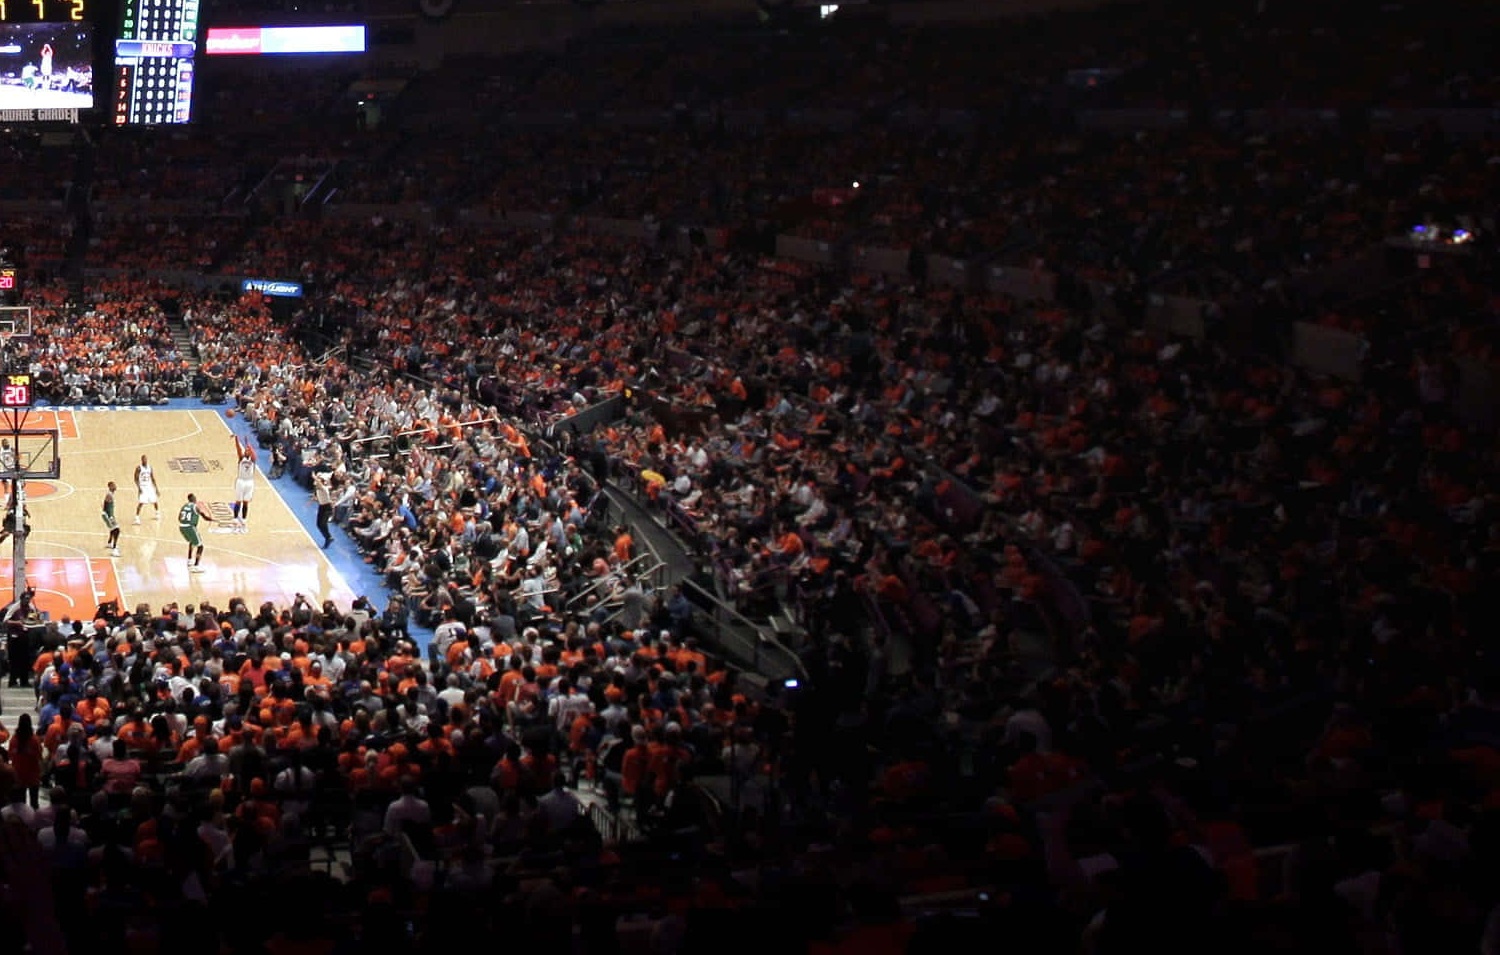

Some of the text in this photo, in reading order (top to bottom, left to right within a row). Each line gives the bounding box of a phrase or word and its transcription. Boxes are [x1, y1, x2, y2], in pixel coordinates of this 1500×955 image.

[71, 0, 84, 20] 2
[38, 108, 79, 124] GARDEN
[5, 386, 27, 405] 20
[181, 511, 192, 522] 34
